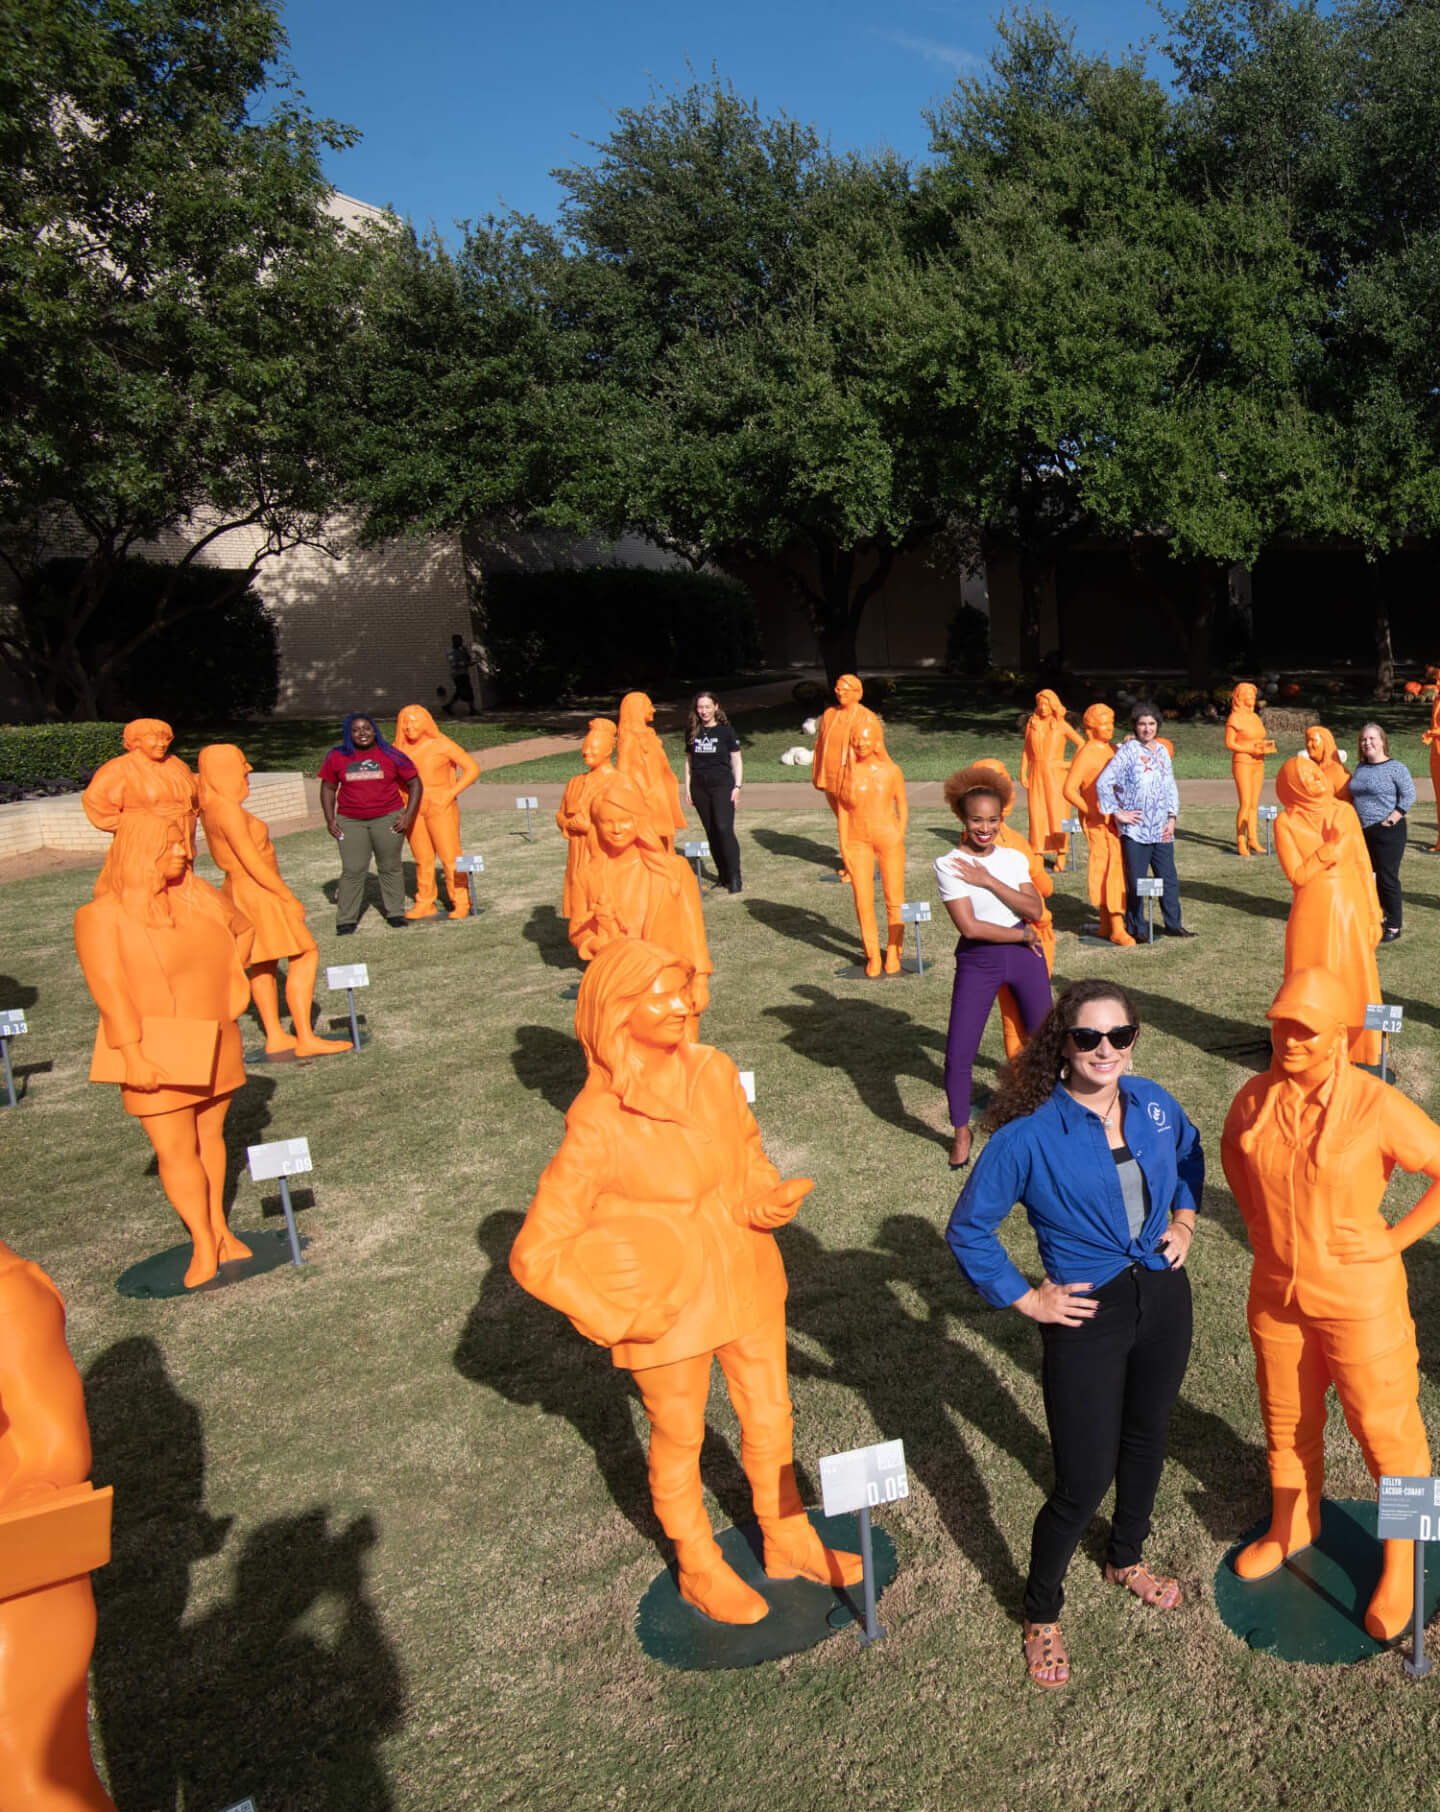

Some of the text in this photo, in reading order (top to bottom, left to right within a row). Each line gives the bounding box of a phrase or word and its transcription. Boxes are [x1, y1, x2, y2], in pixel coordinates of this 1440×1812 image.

[3, 1023, 28, 1036] B.13
[1382, 1020, 1402, 1033] C.12
[866, 1474, 909, 1507] D.05
